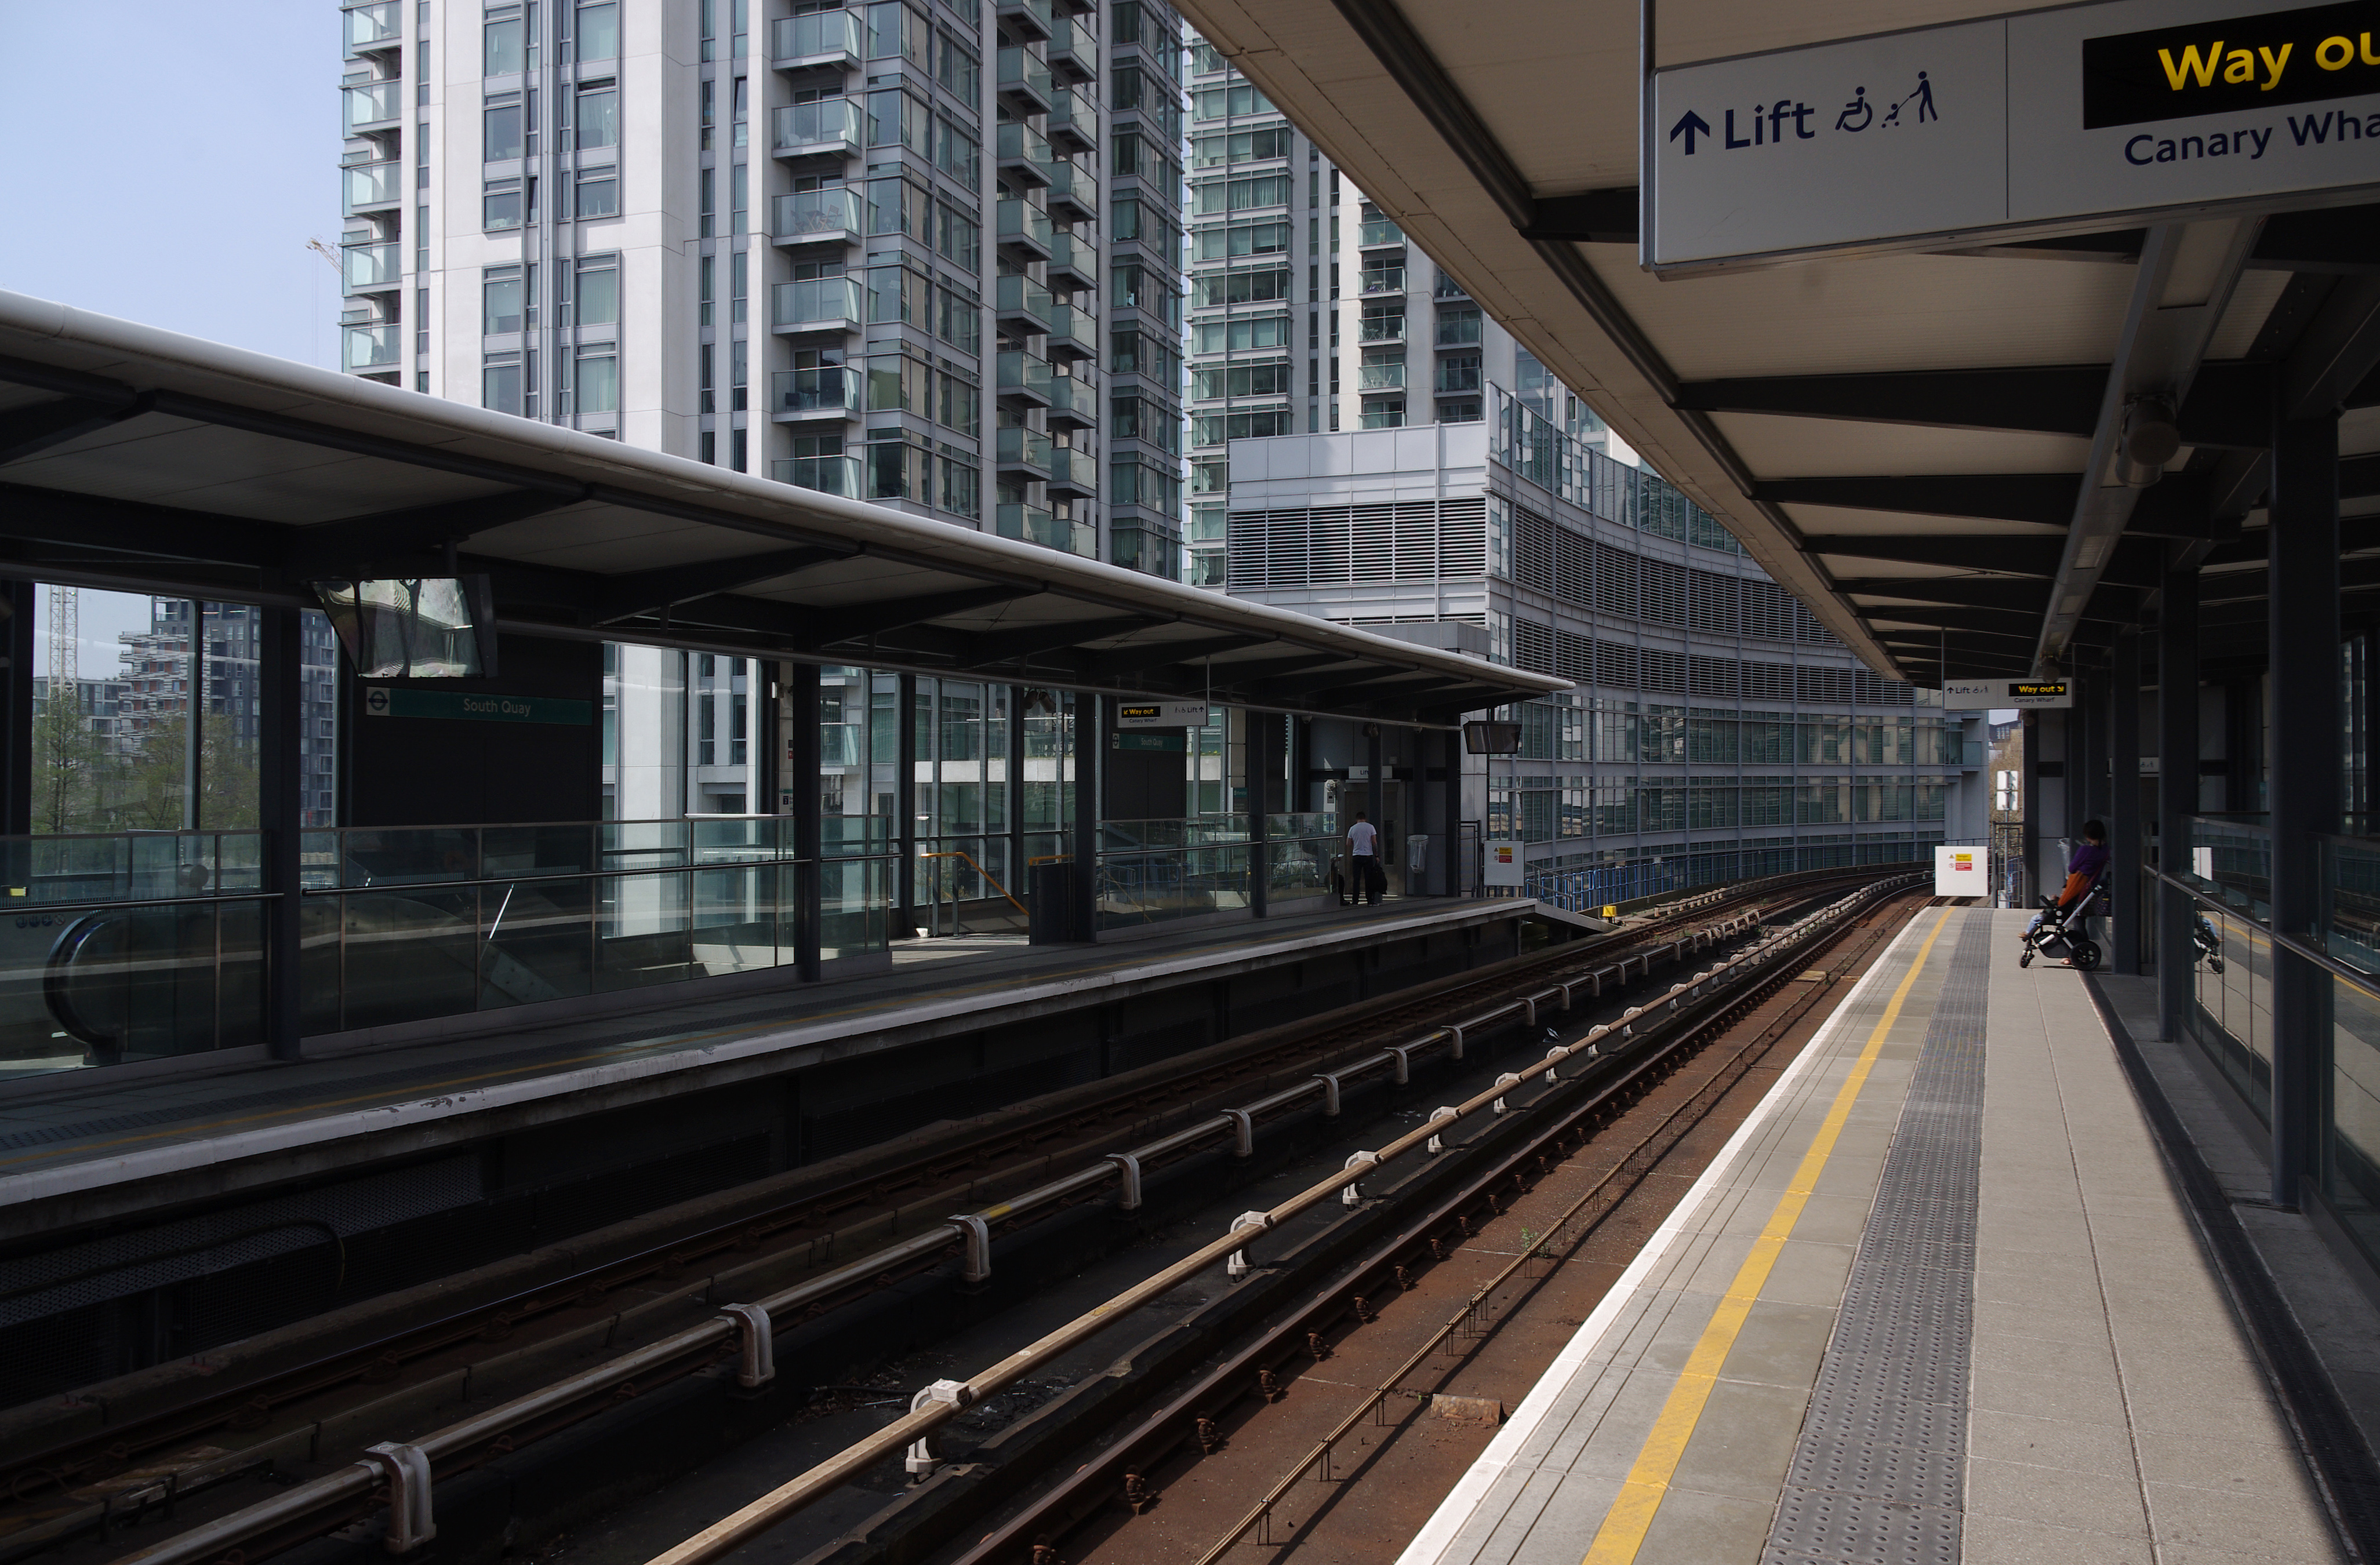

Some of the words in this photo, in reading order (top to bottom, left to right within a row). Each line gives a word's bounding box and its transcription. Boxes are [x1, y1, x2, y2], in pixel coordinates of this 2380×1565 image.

[2157, 40, 2294, 92] Way
[1724, 100, 1816, 150] Lift
[2124, 134, 2273, 166] Canary
[2018, 685, 2038, 694] Way
[464, 697, 499, 713] South
[501, 700, 532, 718] Quay
[1129, 708, 1143, 716] Way
[1141, 737, 1153, 746] South
[1153, 738, 1164, 748] Quay
